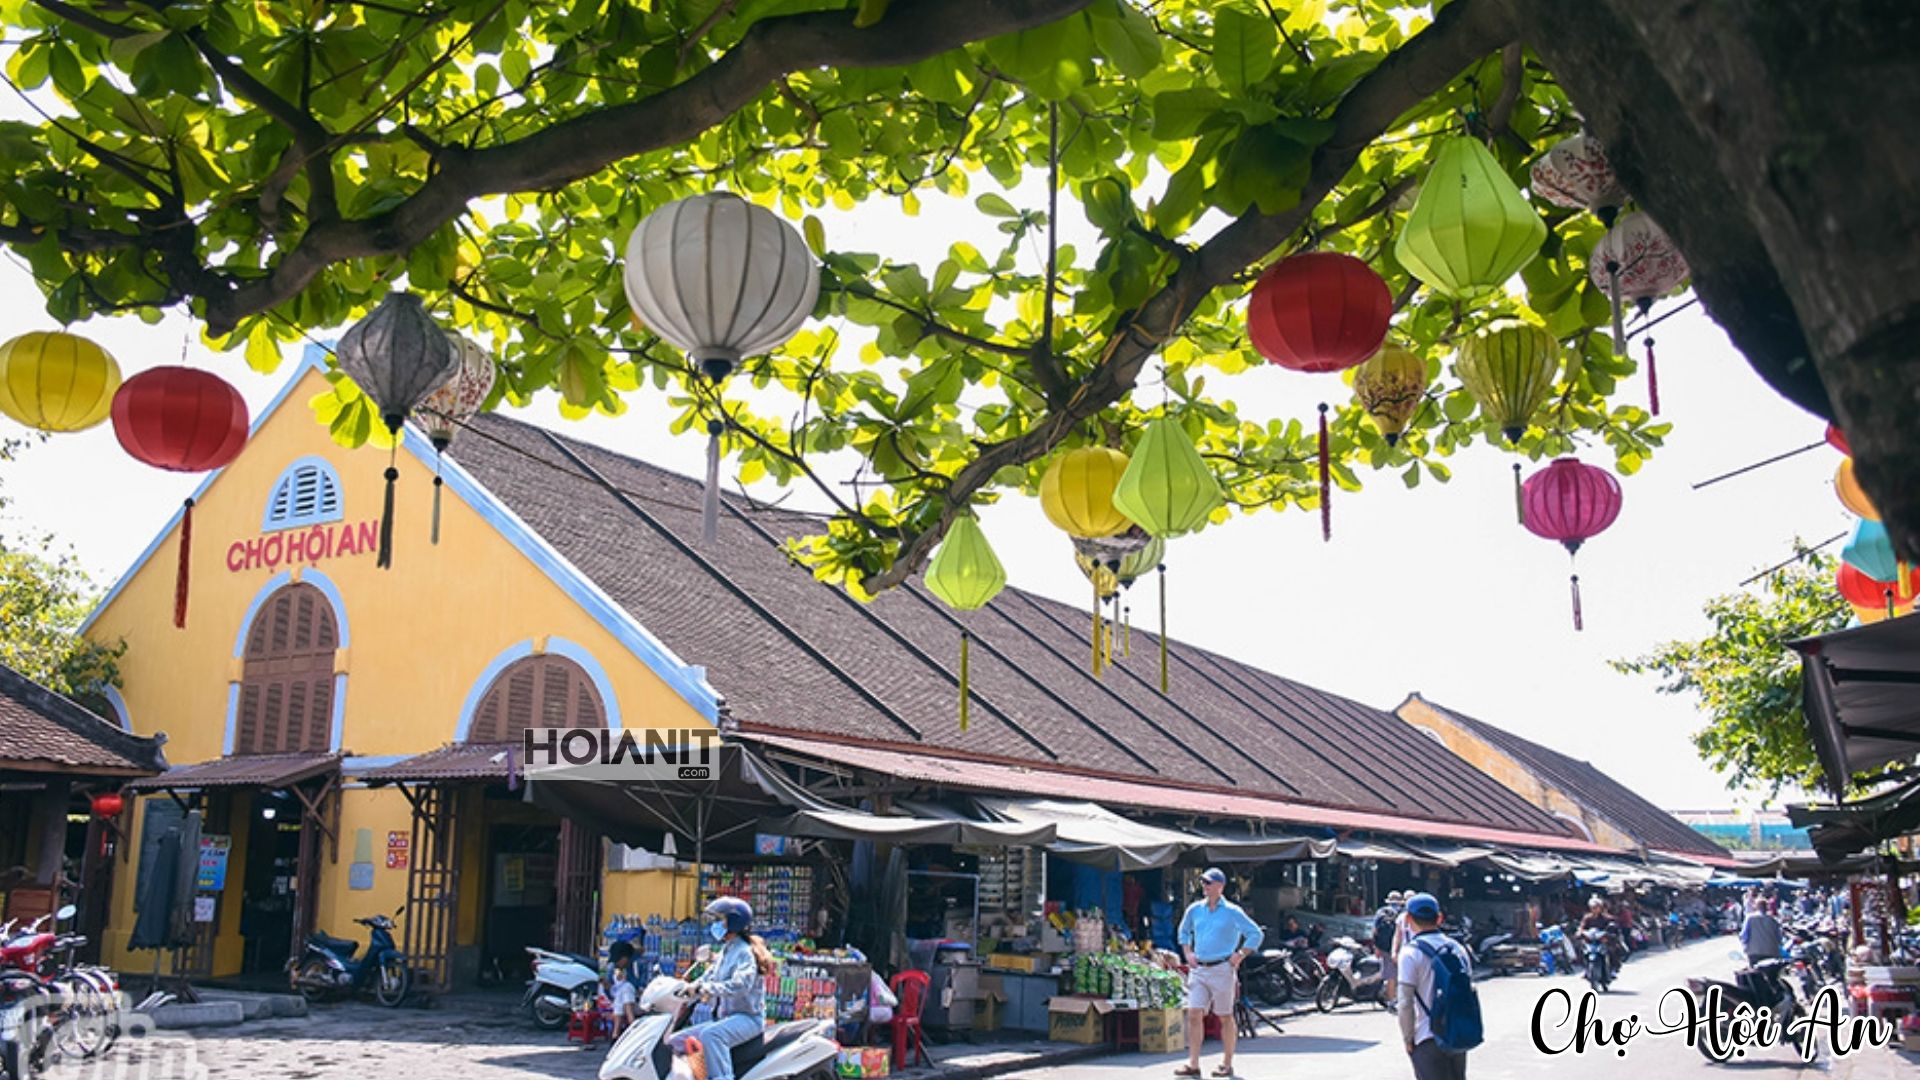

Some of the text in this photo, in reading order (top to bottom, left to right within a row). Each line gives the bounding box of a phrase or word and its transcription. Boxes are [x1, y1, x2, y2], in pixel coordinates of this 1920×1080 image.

[226, 519, 379, 574] CHỢ HỘI AN
